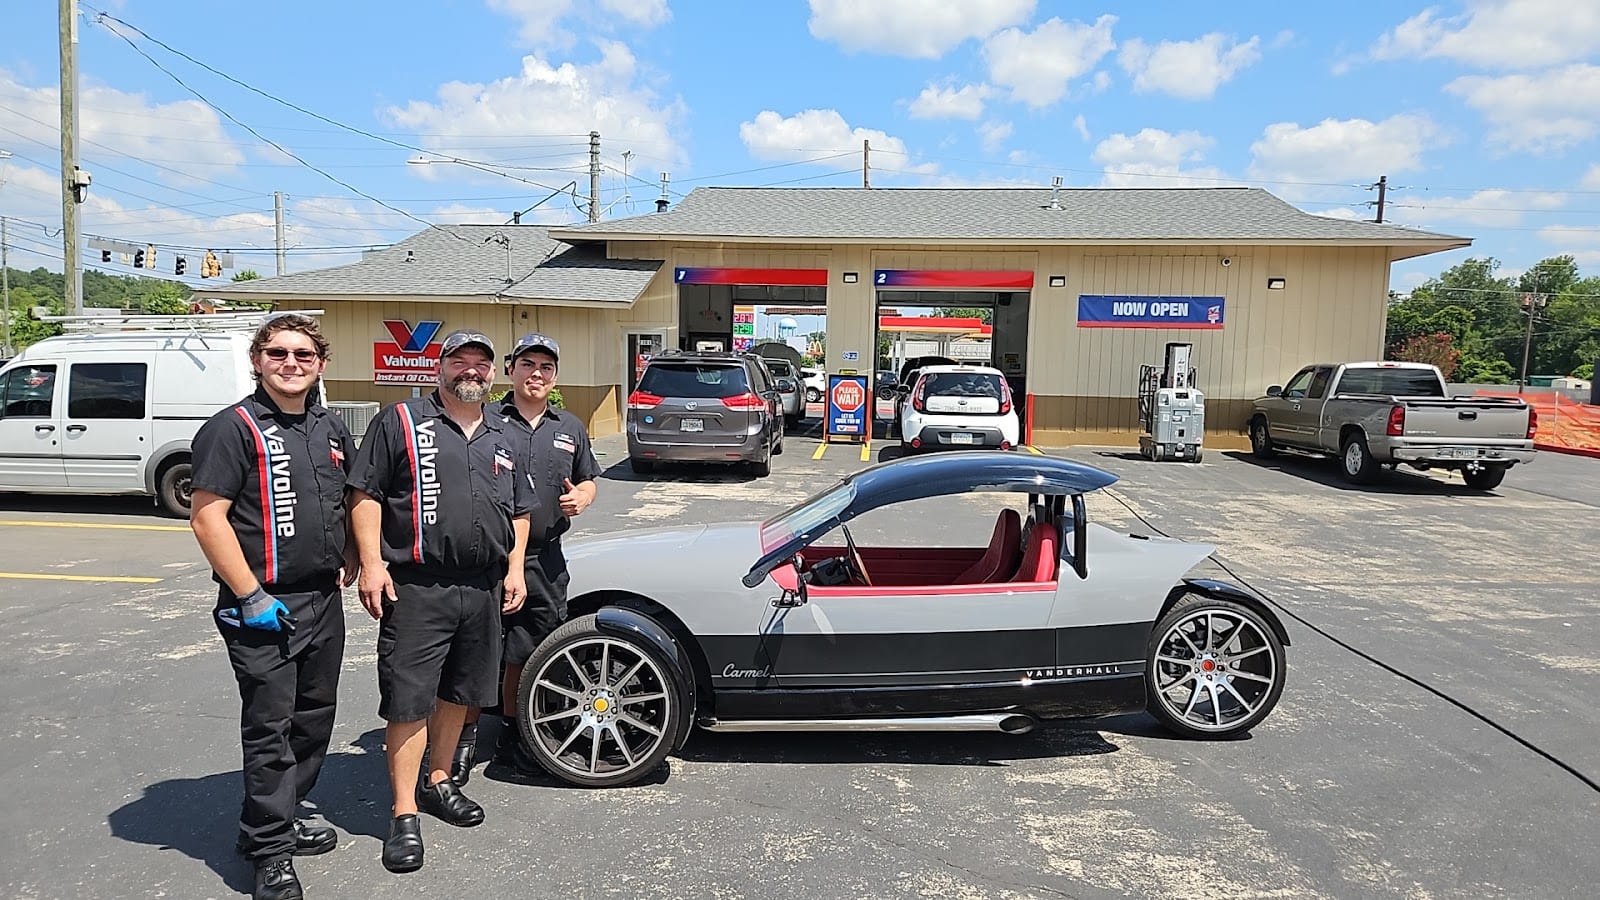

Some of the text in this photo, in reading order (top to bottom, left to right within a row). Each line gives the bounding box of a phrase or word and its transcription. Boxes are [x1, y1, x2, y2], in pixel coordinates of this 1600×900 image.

[877, 273, 887, 284] 2
[1113, 302, 1189, 317] NOW OPEN
[376, 373, 406, 381] Instant
[406, 374, 418, 382] Oil
[837, 394, 860, 405] WAIT
[416, 420, 442, 525] Valvoline
[262, 424, 298, 537] Valvoline
[722, 663, 770, 678] Carmel
[1026, 666, 1120, 677] VANDERHALL
